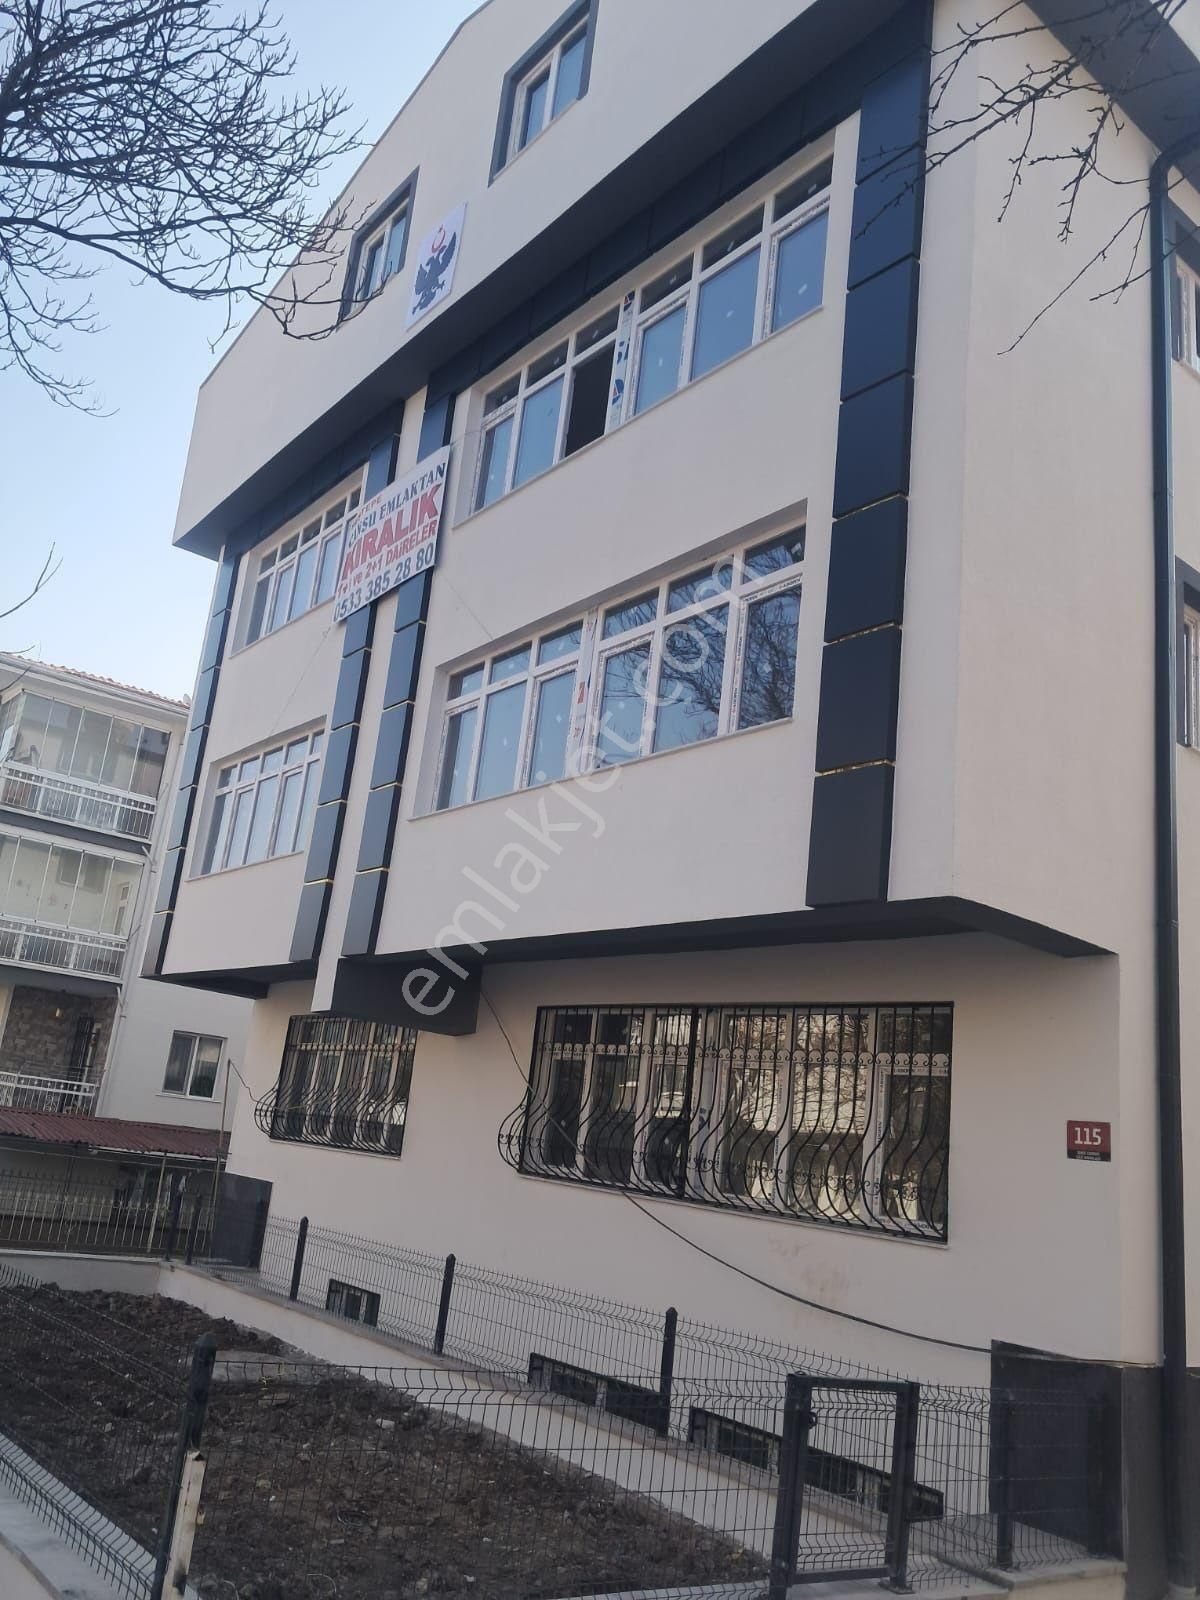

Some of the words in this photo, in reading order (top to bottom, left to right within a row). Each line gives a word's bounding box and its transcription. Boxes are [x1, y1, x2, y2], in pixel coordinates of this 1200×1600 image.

[380, 462, 446, 519] EMLAKTAN
[341, 483, 442, 580] KIRALIK
[333, 588, 361, 622] 0533
[365, 569, 390, 600] 385
[394, 556, 411, 583] 28
[416, 542, 433, 566] 80
[365, 555, 383, 577] 2+1
[1074, 1127, 1102, 1145] 115
